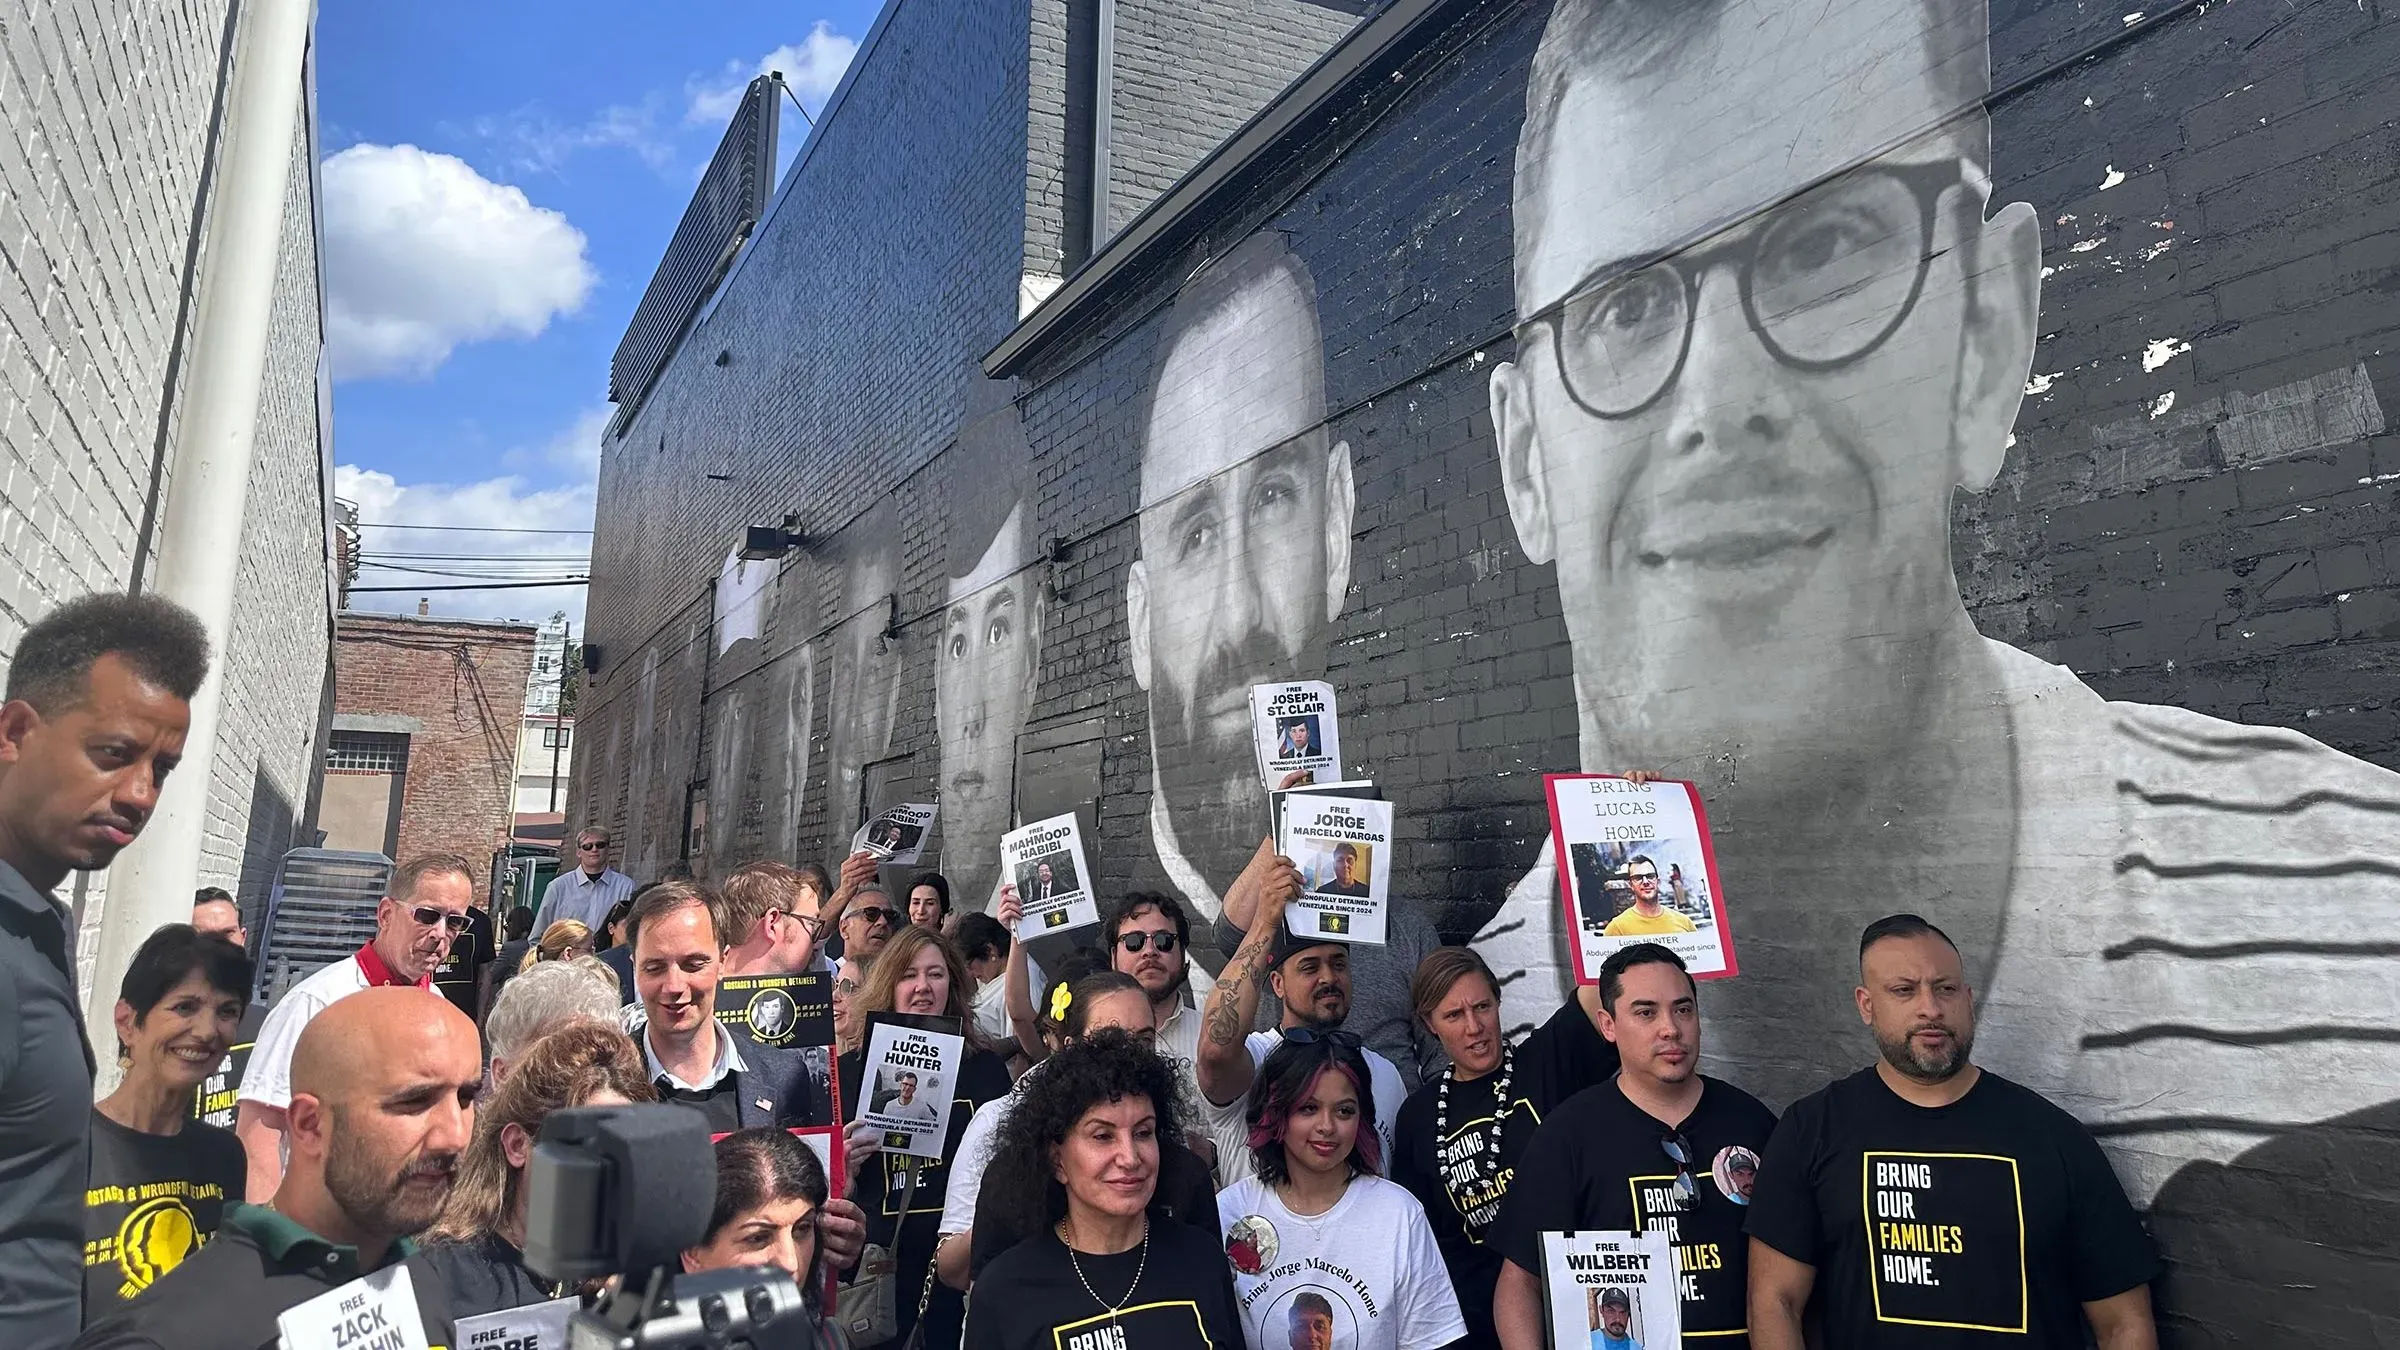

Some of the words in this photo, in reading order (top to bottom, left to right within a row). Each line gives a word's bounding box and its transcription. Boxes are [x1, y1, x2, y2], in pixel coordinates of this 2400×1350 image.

[1272, 692, 1318, 705] JOSEPH
[1267, 706, 1286, 716] ST.
[1288, 703, 1325, 714] CLAIR
[1589, 781, 1651, 794] BRING
[1329, 806, 1350, 814] FREE
[1595, 801, 1656, 817] LUCAS
[1314, 814, 1366, 829] JORGE
[1029, 826, 1044, 835] FREE
[1293, 827, 1342, 838] MARCELO
[1344, 831, 1385, 843] VARGAS
[1605, 825, 1655, 840] HOME
[1009, 826, 1071, 853] MAHMOOD
[1020, 840, 1062, 860] HABIBI
[1054, 893, 1078, 903] DETAINED
[1058, 900, 1073, 908] SINCE
[1338, 898, 1369, 907] DETAINED
[1298, 902, 1335, 911] VENEZUELA
[1356, 906, 1373, 914] 2024
[1697, 943, 1716, 951] since
[908, 1034, 927, 1043] FREE
[892, 1040, 939, 1058] LUCAS
[884, 1052, 942, 1071] HUNTER
[206, 1074, 226, 1094] OUR
[864, 1114, 903, 1125] WRONGFULLY
[903, 1119, 931, 1128] DETAINED
[866, 1122, 900, 1131] VENEZUELA
[1448, 1132, 1484, 1164] BRING
[892, 1171, 927, 1191] HOE.
[1876, 1162, 1932, 1189] BRING
[128, 1187, 136, 1202] &
[1877, 1190, 1916, 1219] OUR
[1879, 1222, 1963, 1254] FAMILIES
[1595, 1243, 1620, 1252] FREE
[1566, 1254, 1651, 1270] WILBERT
[1882, 1254, 1940, 1286] HOME.
[1576, 1273, 1647, 1284] CASTANEDA
[1241, 1281, 1269, 1310] Bring
[1269, 1262, 1301, 1282] Jorge
[1304, 1257, 1354, 1284] Marcelo
[1352, 1279, 1379, 1319] Home
[339, 1293, 366, 1315] FREE
[331, 1303, 388, 1348] ZACK
[471, 1327, 506, 1345] FREE
